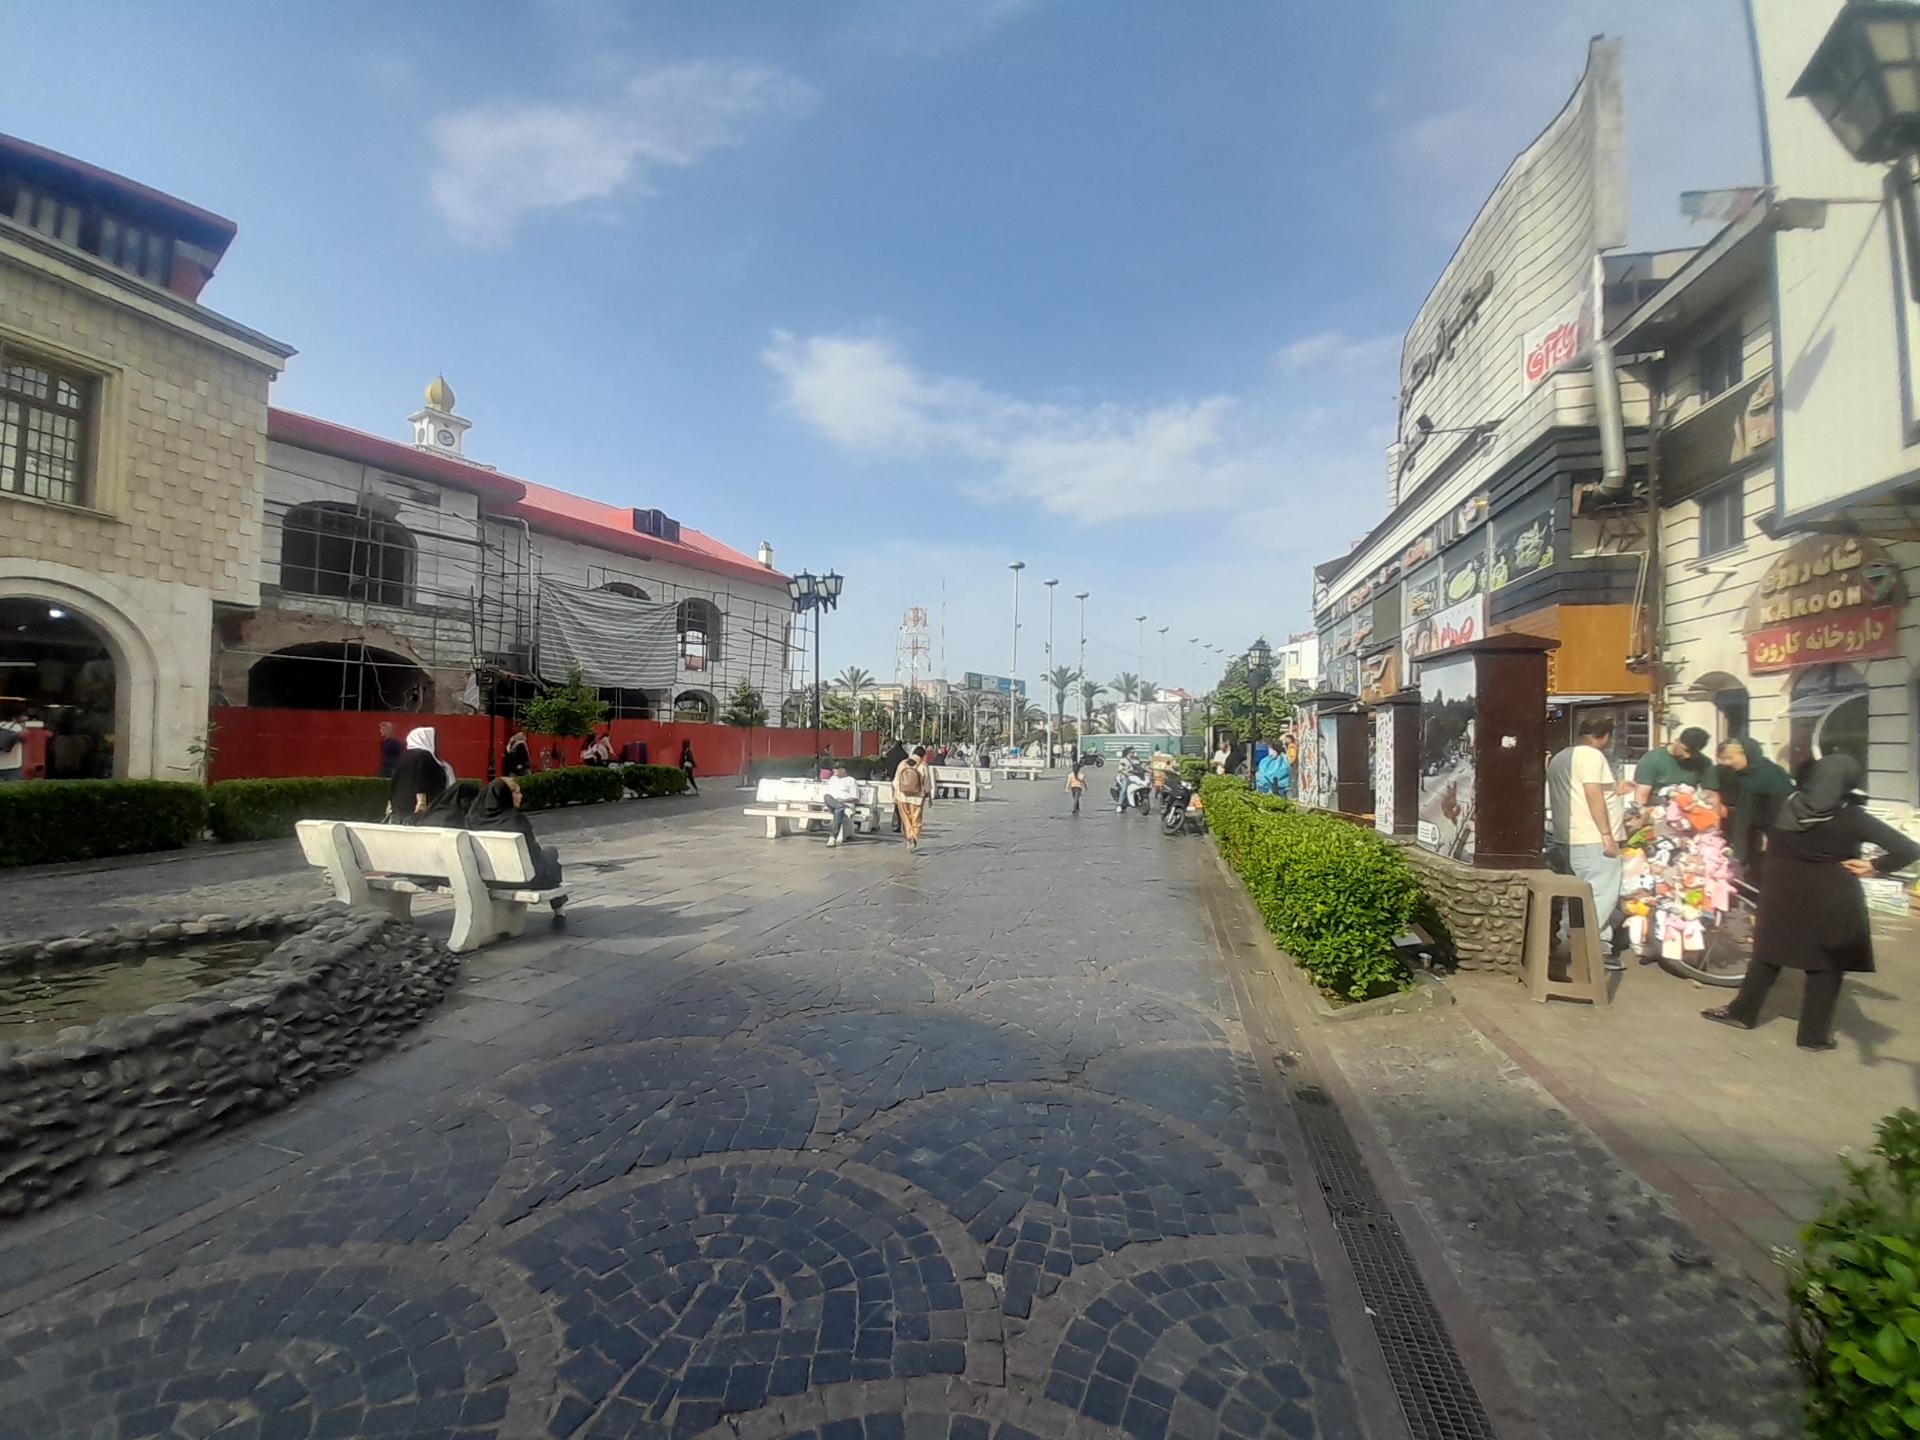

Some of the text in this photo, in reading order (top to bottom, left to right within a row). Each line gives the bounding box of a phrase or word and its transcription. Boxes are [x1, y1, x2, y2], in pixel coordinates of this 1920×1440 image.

[1760, 585, 1861, 624] KAROON
[1754, 617, 1883, 663] داروخانه کارون
